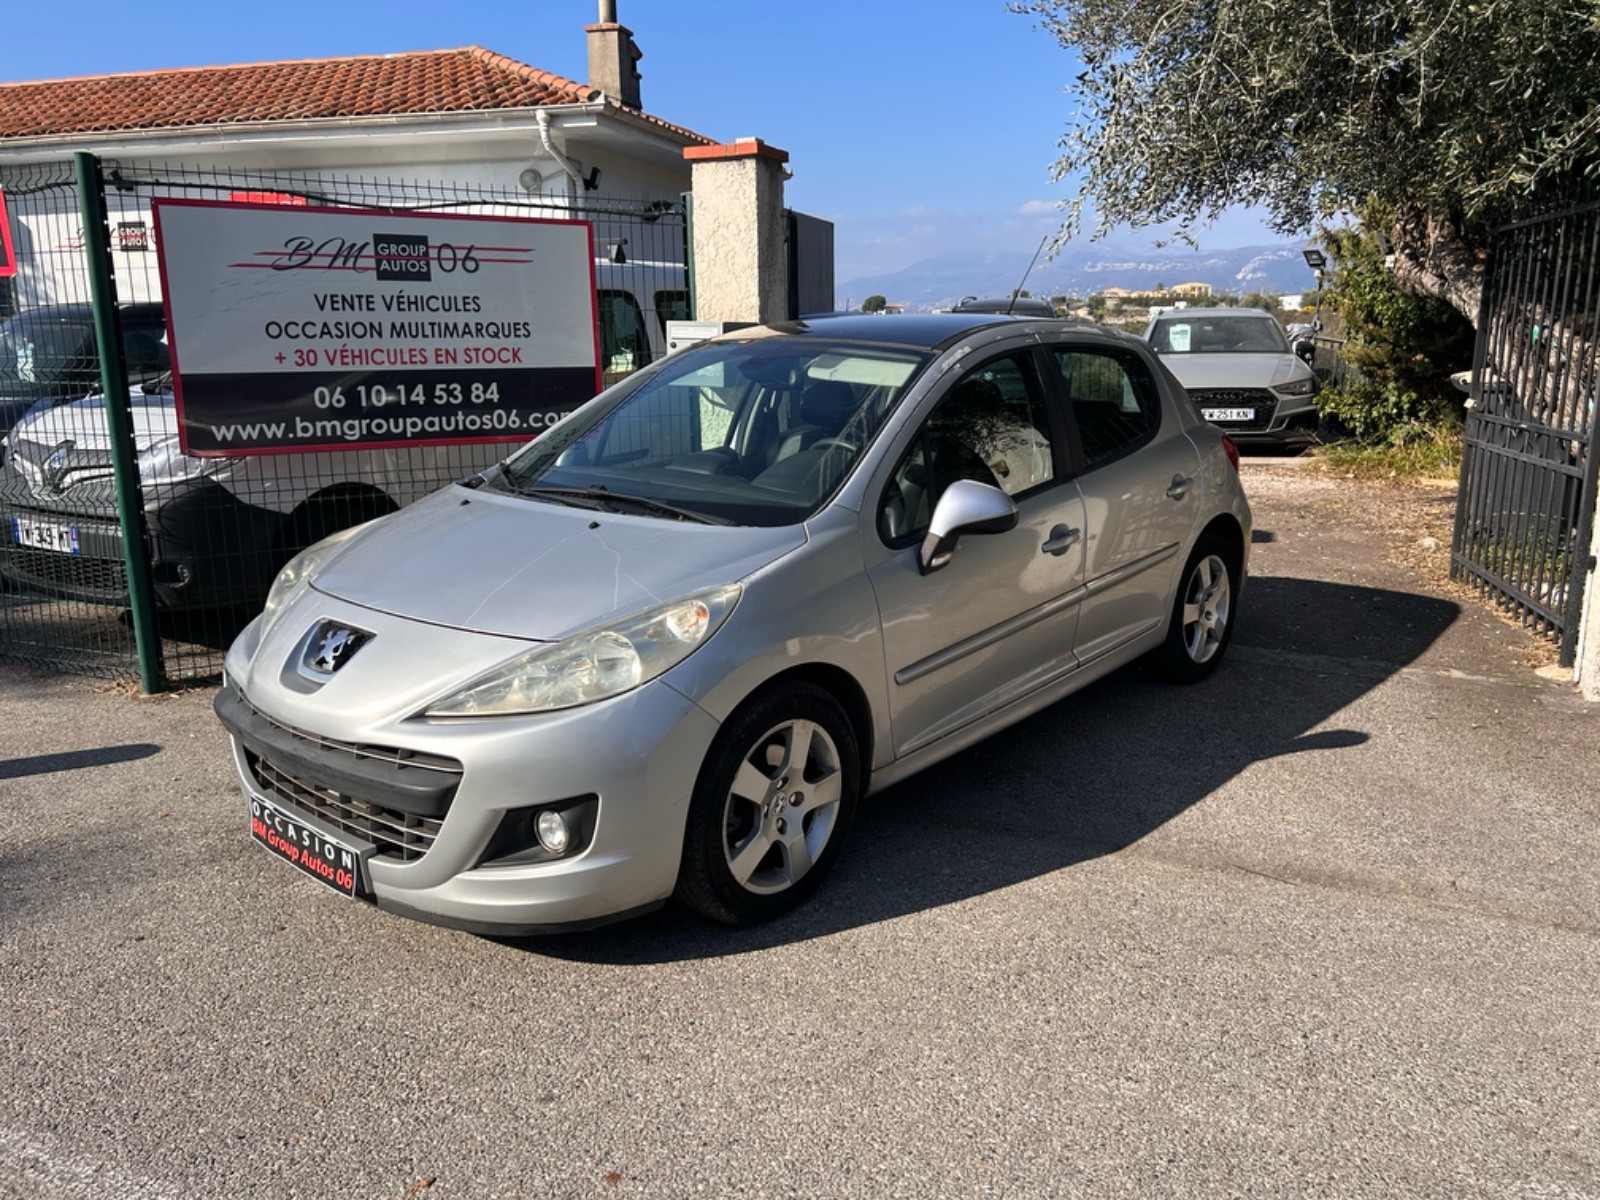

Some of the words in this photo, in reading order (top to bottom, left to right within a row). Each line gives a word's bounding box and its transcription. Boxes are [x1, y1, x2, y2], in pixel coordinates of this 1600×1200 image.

[271, 236, 371, 274] BM
[377, 242, 427, 258] GROUP
[437, 242, 480, 274] 06
[379, 258, 428, 274] AUTOS
[313, 293, 376, 312] VENTE
[381, 290, 482, 314] VÉHICULES
[264, 320, 384, 340] OCCASION
[389, 321, 531, 340] MULTIMARQUES
[274, 352, 288, 366] +
[294, 348, 319, 368] 30
[323, 343, 428, 368] VÉHICULES
[434, 347, 458, 365] EN
[463, 346, 523, 364] STOCK
[313, 385, 346, 410] 06
[356, 384, 387, 408] 10
[398, 383, 425, 406] 14
[433, 382, 463, 405] 53
[470, 381, 500, 404] 84
[252, 801, 353, 869] OCCASION
[252, 816, 267, 839] BM
[267, 829, 299, 861] Group
[301, 849, 335, 879] Autos
[336, 869, 353, 889] 06
